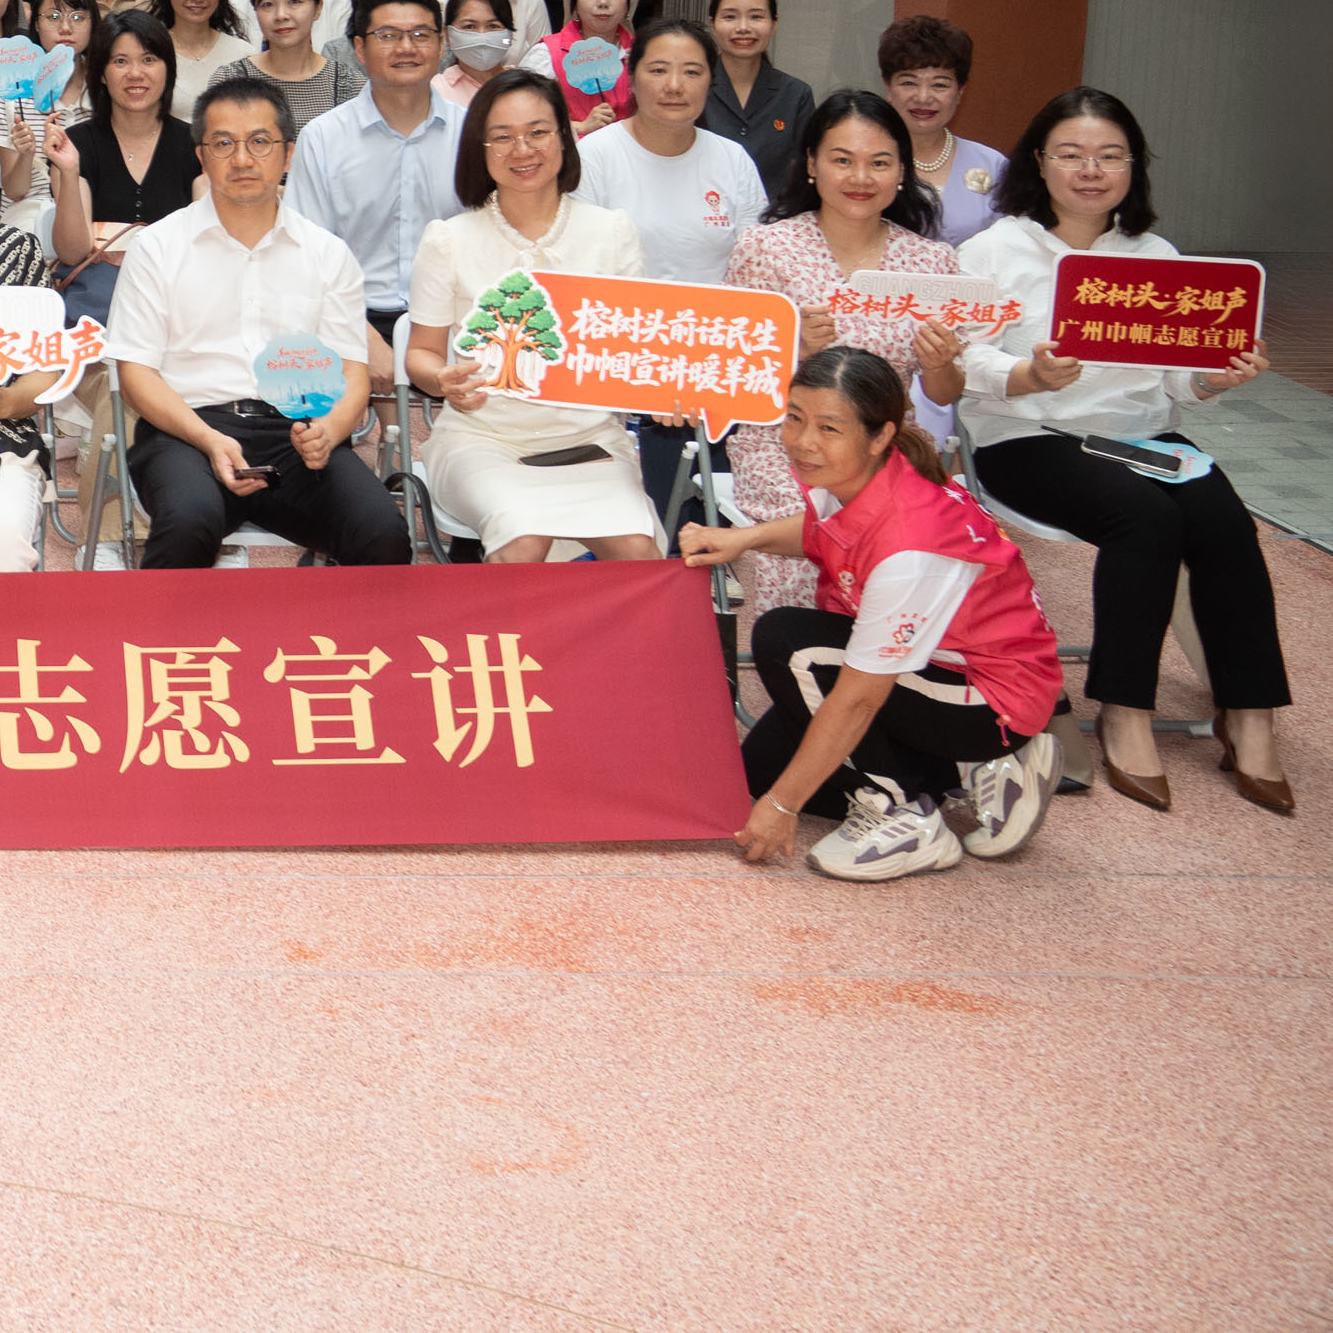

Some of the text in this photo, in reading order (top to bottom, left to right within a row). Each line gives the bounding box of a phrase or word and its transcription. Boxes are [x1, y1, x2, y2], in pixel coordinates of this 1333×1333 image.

[568, 298, 781, 355] 榕树头前话民生
[827, 288, 1022, 338] 榕树头·家姐声
[1073, 277, 1248, 326] 榕树头·家姐声
[1057, 319, 1249, 350] 广州巾帼志愿宣讲
[566, 343, 784, 409] 巾帼宣讲暖羊城
